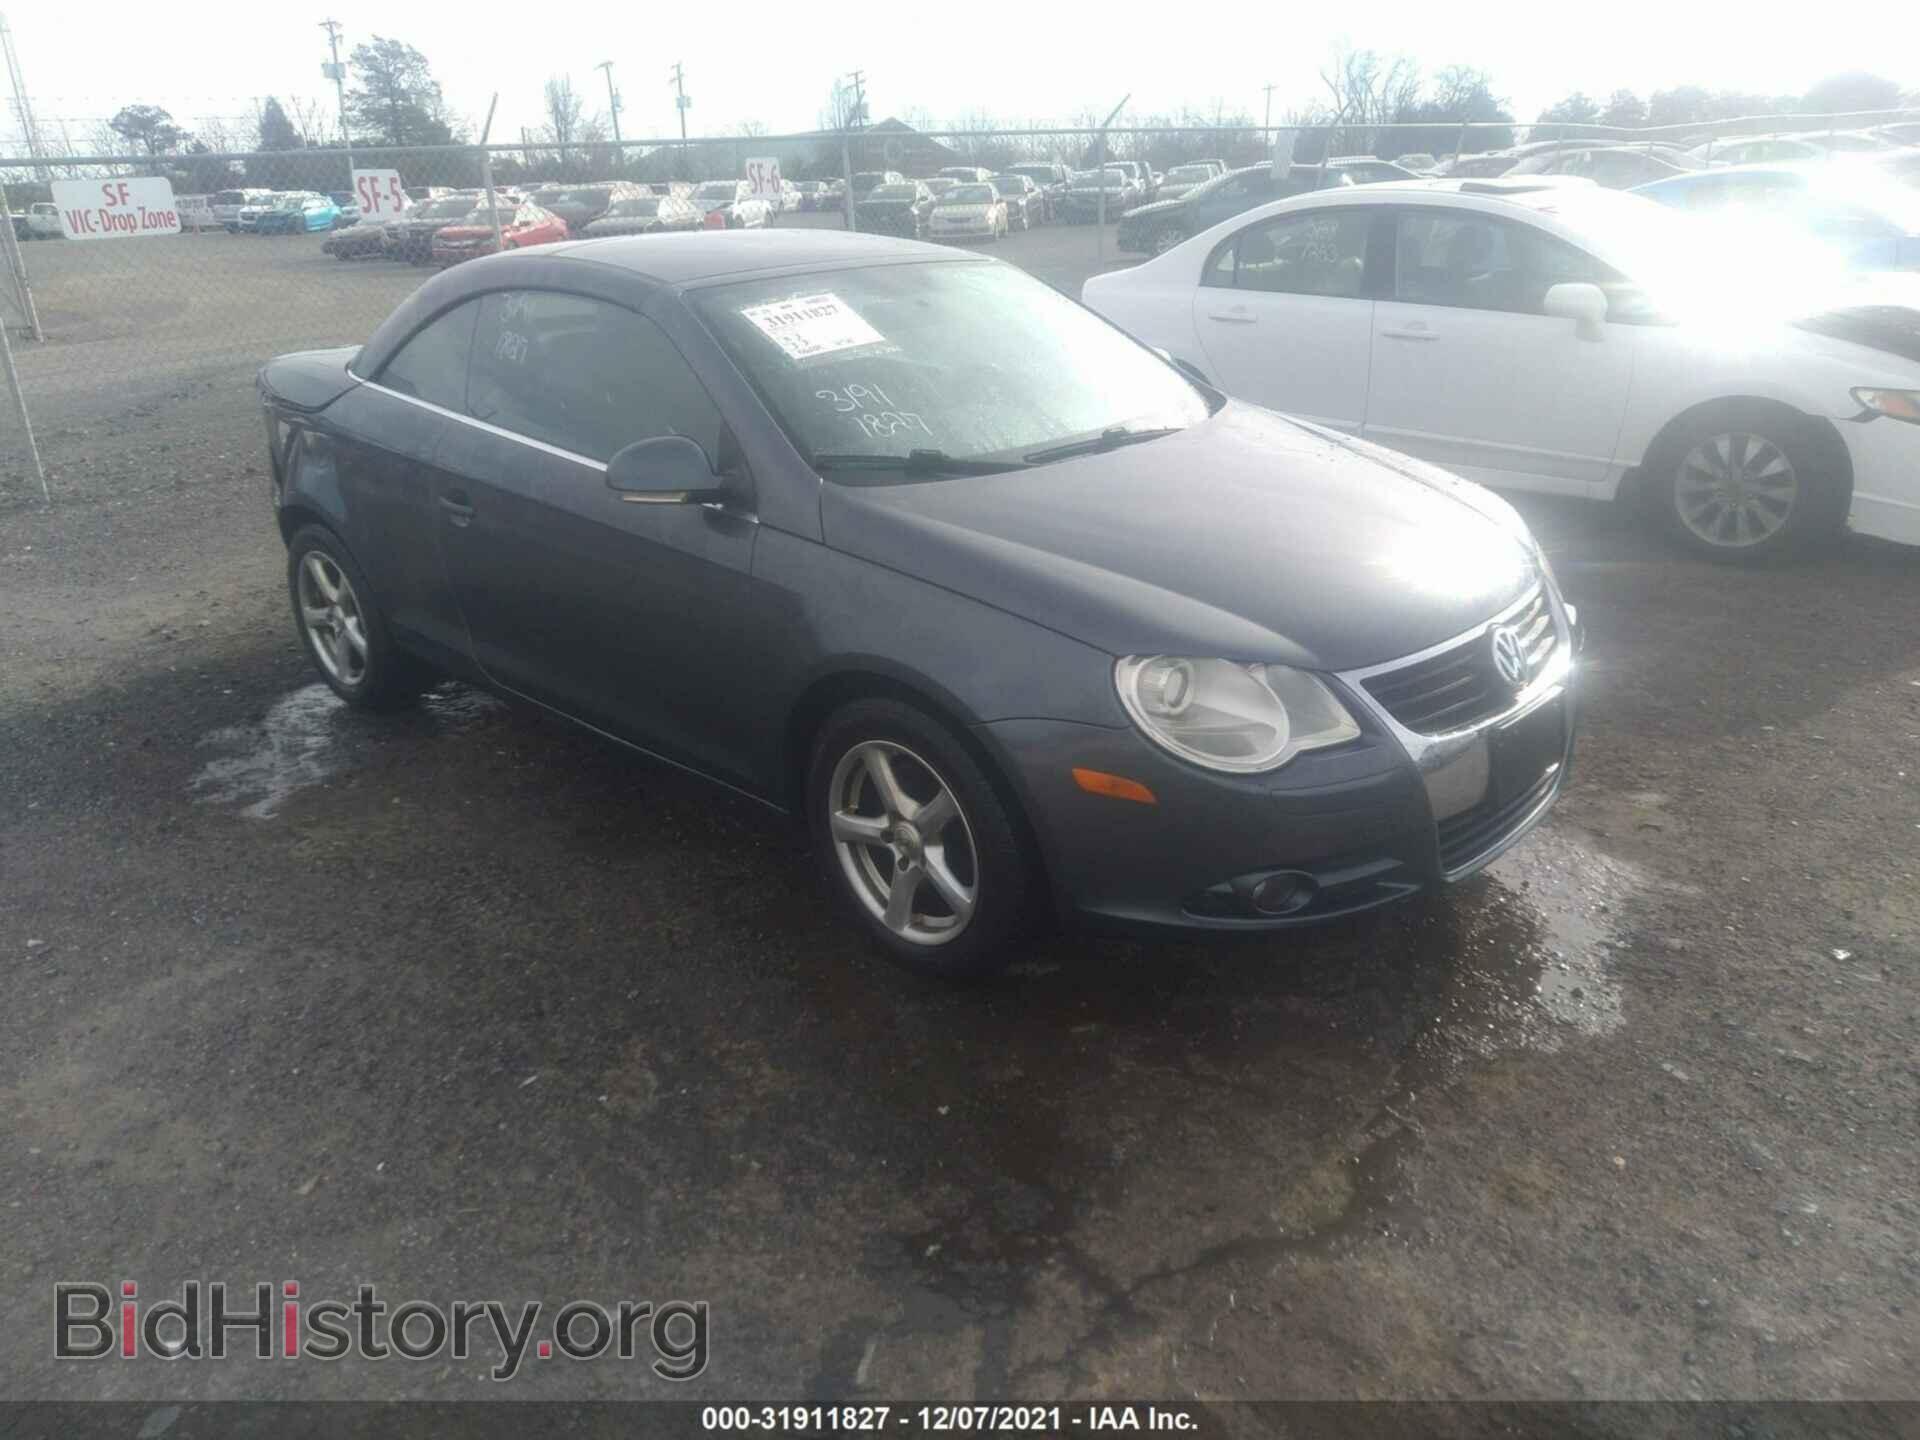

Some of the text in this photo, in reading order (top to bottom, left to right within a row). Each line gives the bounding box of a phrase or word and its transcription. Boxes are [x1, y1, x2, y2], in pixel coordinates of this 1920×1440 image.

[747, 163, 781, 193] SF-6
[101, 183, 130, 207] SF
[358, 176, 402, 213] SF-5
[65, 206, 177, 234] VIC-Drop Zone
[764, 304, 839, 328] 31911827
[815, 383, 895, 413] 3191
